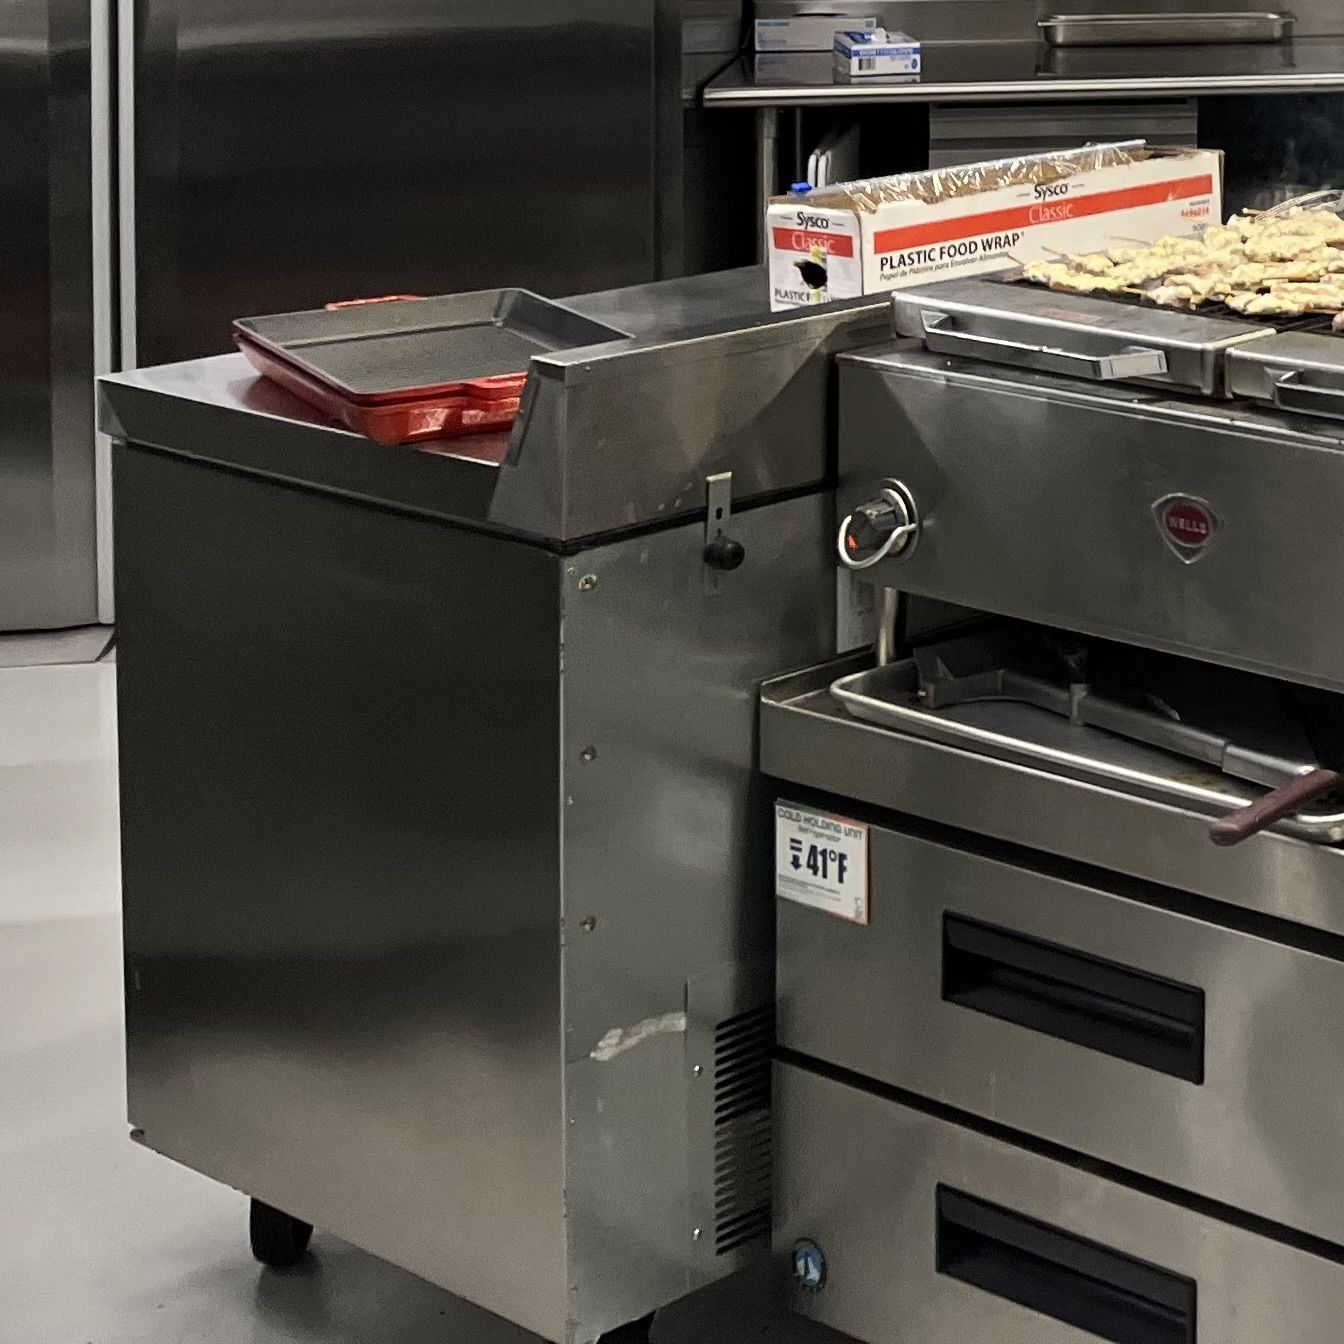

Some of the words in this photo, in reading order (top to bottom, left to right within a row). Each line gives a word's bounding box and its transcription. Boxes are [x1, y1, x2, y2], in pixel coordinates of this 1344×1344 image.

[1034, 183, 1069, 202] Sysco
[796, 211, 830, 230] Sysco
[1028, 202, 1074, 224] Classic
[880, 248, 936, 271] PLASTIC
[939, 240, 978, 260] FOOD
[981, 232, 1021, 252] WRAP
[774, 287, 806, 302] PLASTIC
[1167, 515, 1207, 535] WELLS
